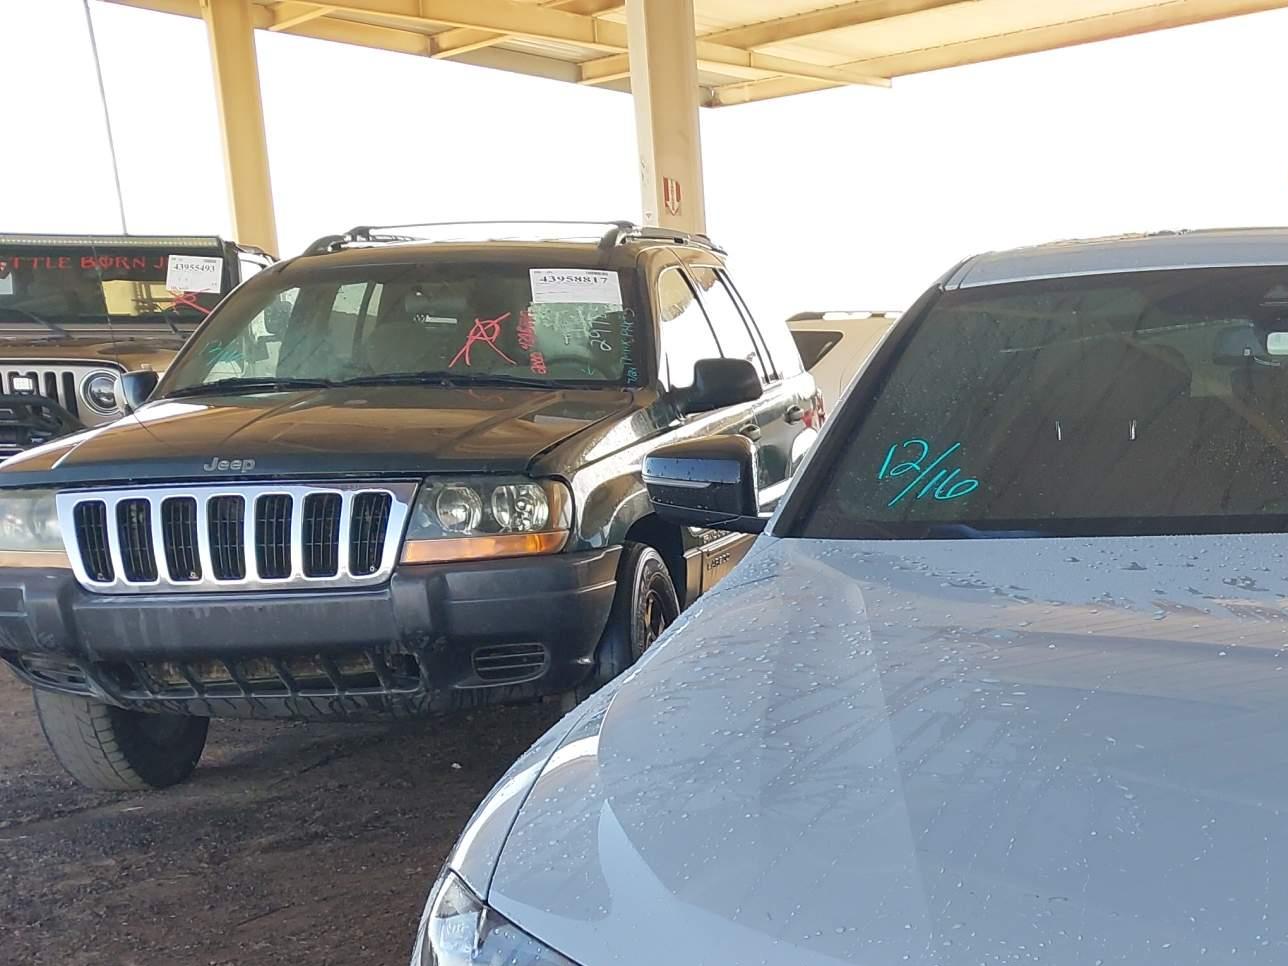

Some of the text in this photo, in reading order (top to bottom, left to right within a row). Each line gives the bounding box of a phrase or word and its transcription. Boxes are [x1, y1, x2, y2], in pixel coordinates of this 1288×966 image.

[174, 263, 216, 272] 43955493
[540, 275, 608, 284] 43958817
[203, 456, 256, 473] Jeep
[878, 438, 979, 507] 12/16
